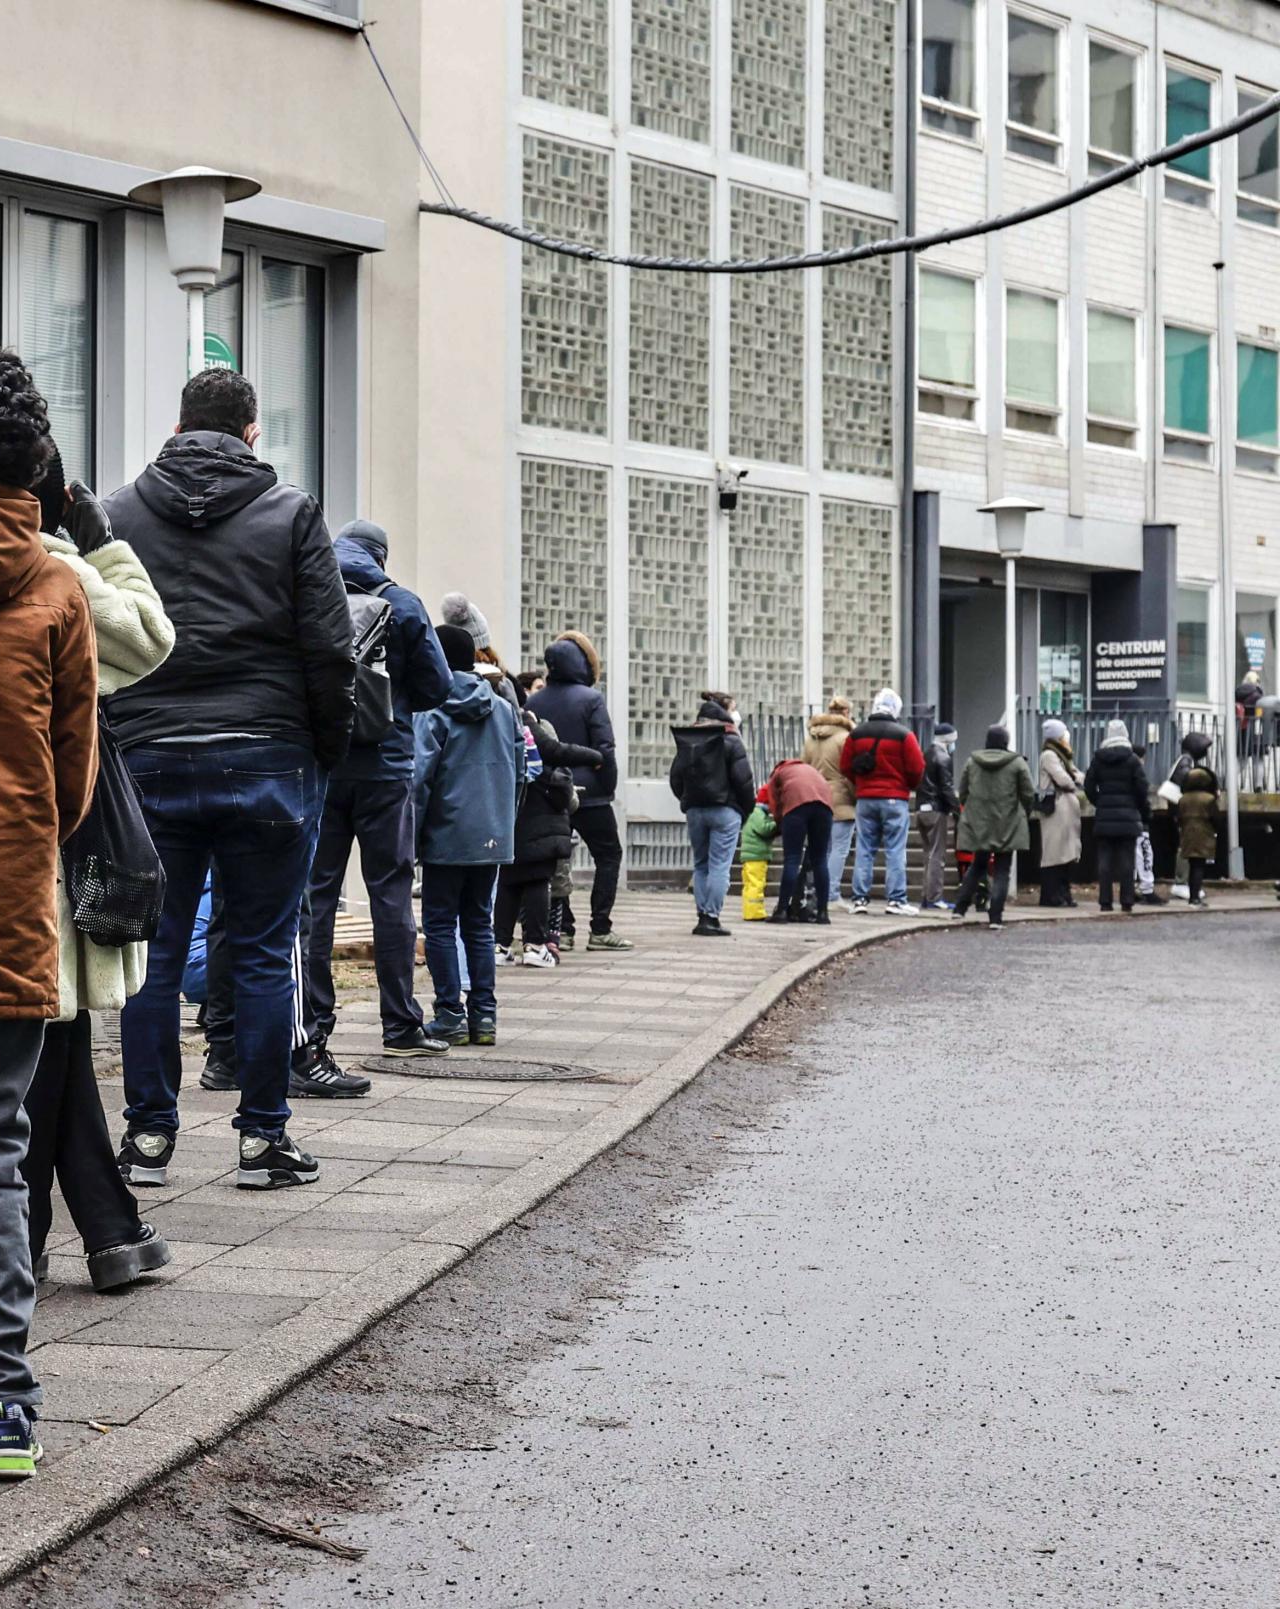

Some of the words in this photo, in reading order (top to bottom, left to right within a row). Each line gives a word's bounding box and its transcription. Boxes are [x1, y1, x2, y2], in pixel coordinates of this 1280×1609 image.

[1096, 640, 1166, 656] CENTRUM
[1096, 657, 1112, 668] FÜR
[1113, 656, 1165, 668] GESUNDHEIT
[1096, 669, 1162, 680] SERVICECENTER
[1096, 681, 1138, 691] WEDDING
